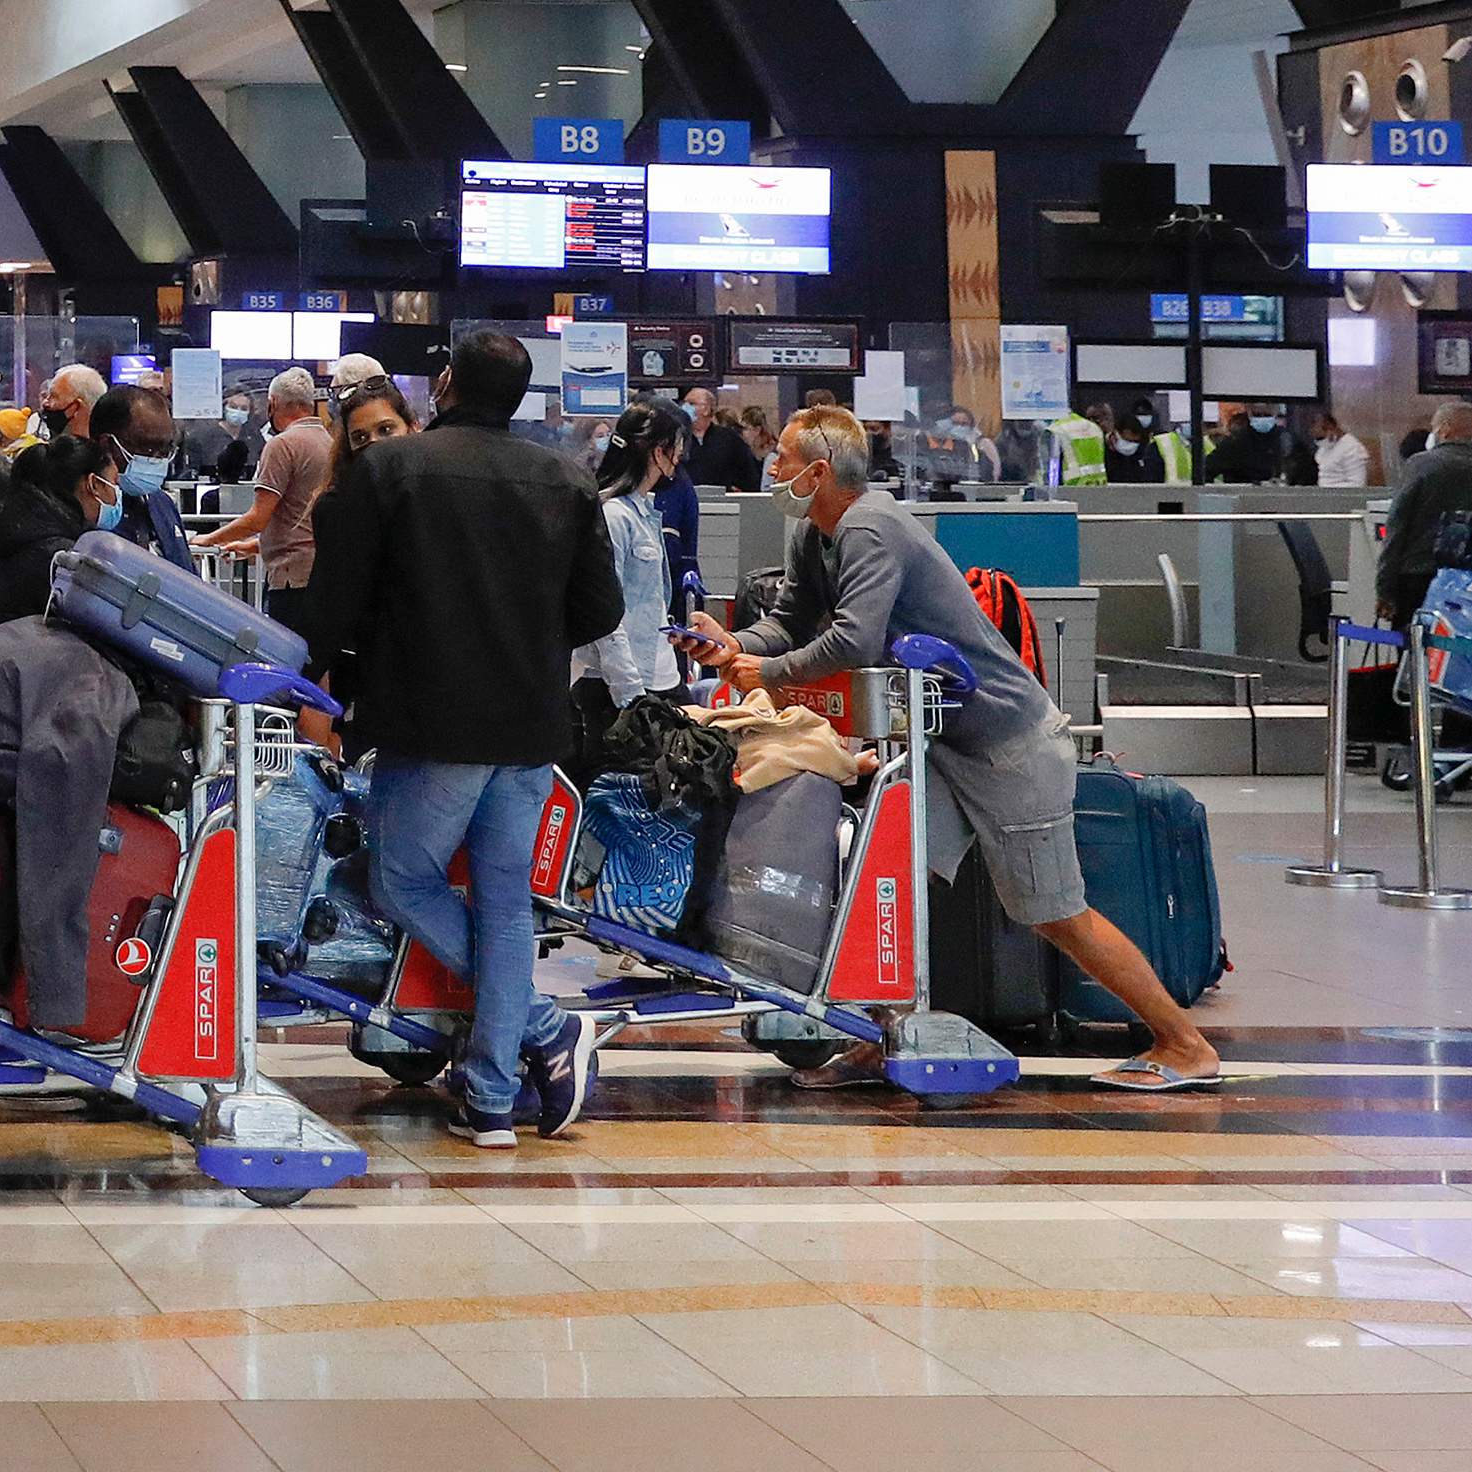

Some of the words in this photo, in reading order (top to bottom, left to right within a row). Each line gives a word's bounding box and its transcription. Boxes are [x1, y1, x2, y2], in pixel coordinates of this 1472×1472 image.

[560, 125, 600, 153] B8
[687, 127, 726, 155] B9
[1389, 128, 1448, 156] B10
[250, 296, 276, 308] B35
[307, 296, 333, 309] B36
[580, 299, 606, 311] B37
[788, 692, 826, 710] SPAR
[540, 826, 560, 870] SPAR
[880, 903, 894, 964] SPAR
[199, 968, 213, 1037] SPAR
